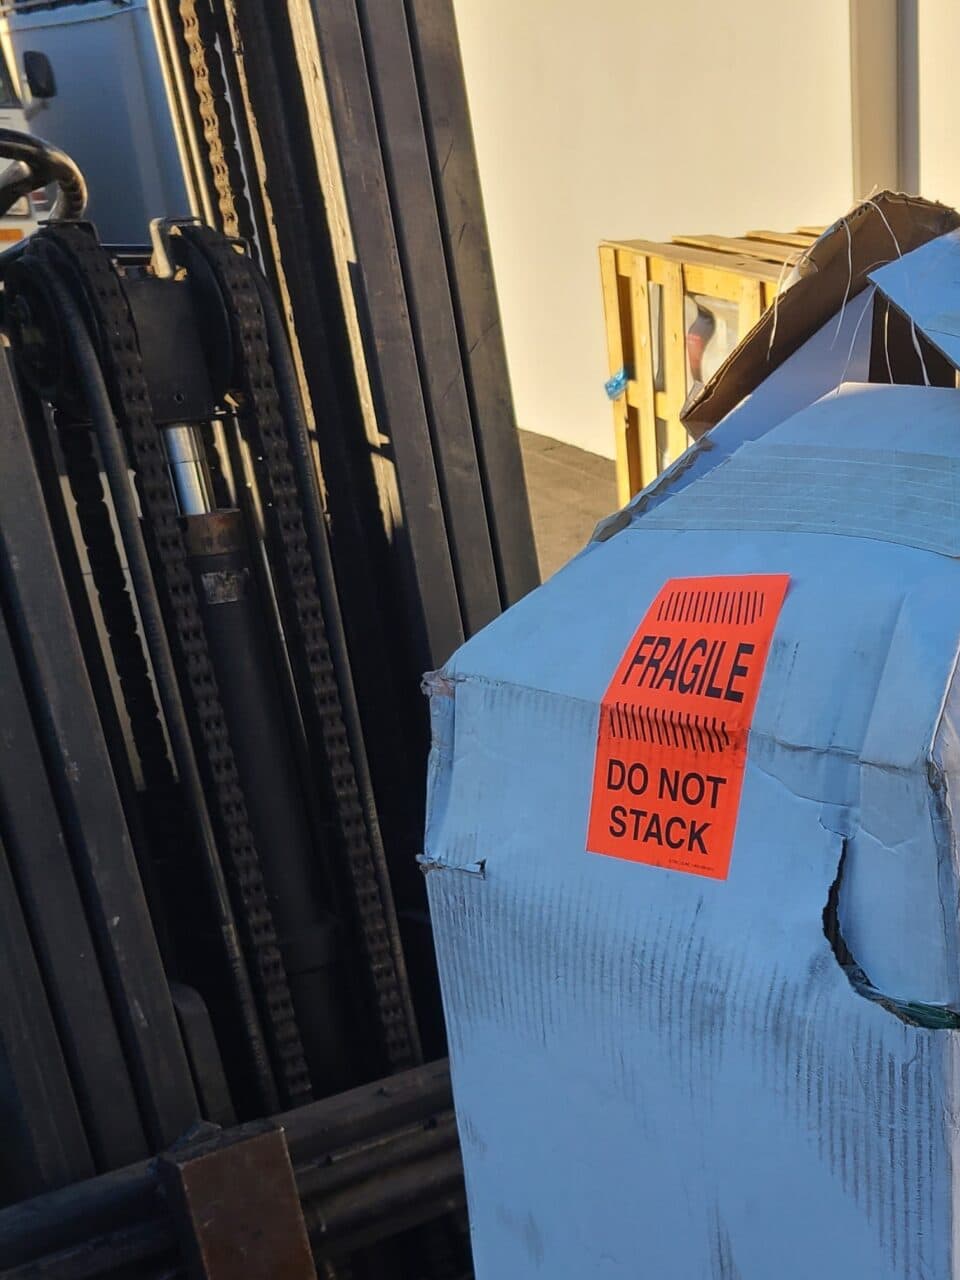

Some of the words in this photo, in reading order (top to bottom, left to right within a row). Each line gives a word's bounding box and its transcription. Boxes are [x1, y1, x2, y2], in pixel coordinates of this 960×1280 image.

[621, 635, 755, 704] FRAGILE
[606, 758, 649, 796] DO
[657, 767, 727, 809] NOT
[608, 805, 712, 855] STACK
